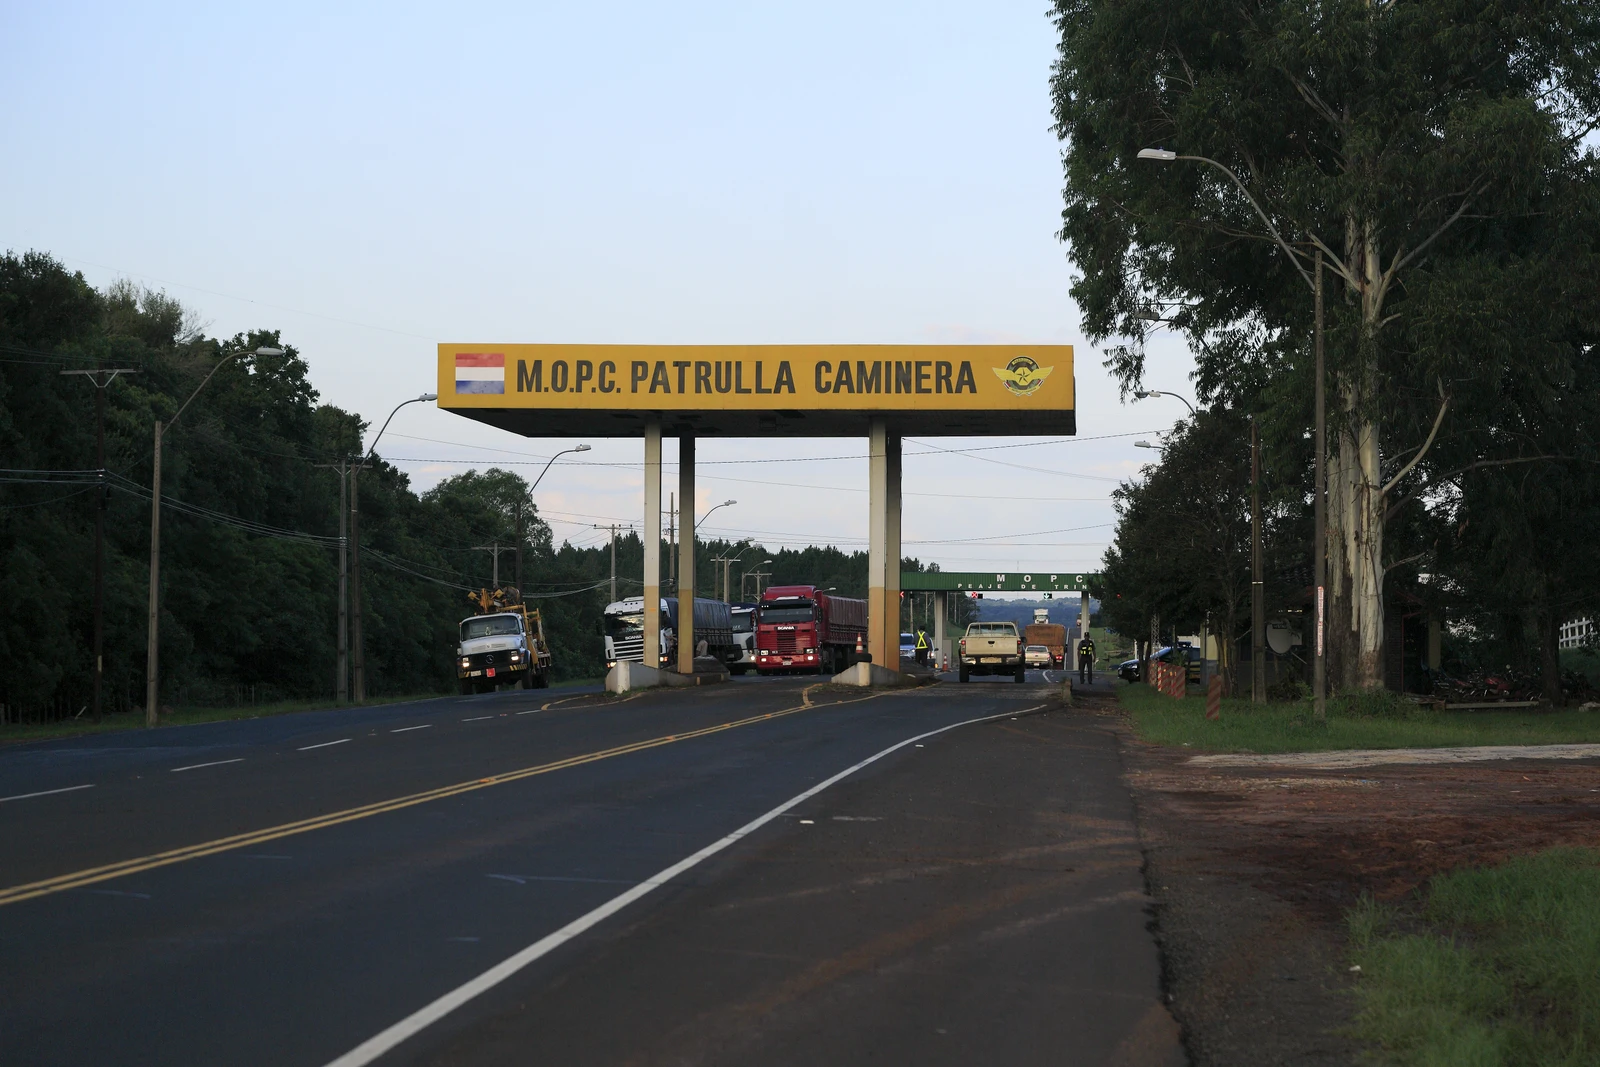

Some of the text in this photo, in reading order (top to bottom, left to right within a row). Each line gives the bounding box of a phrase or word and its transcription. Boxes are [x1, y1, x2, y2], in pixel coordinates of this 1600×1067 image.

[517, 360, 977, 394] M.O.P.C. PATRULLA CAMINERA
